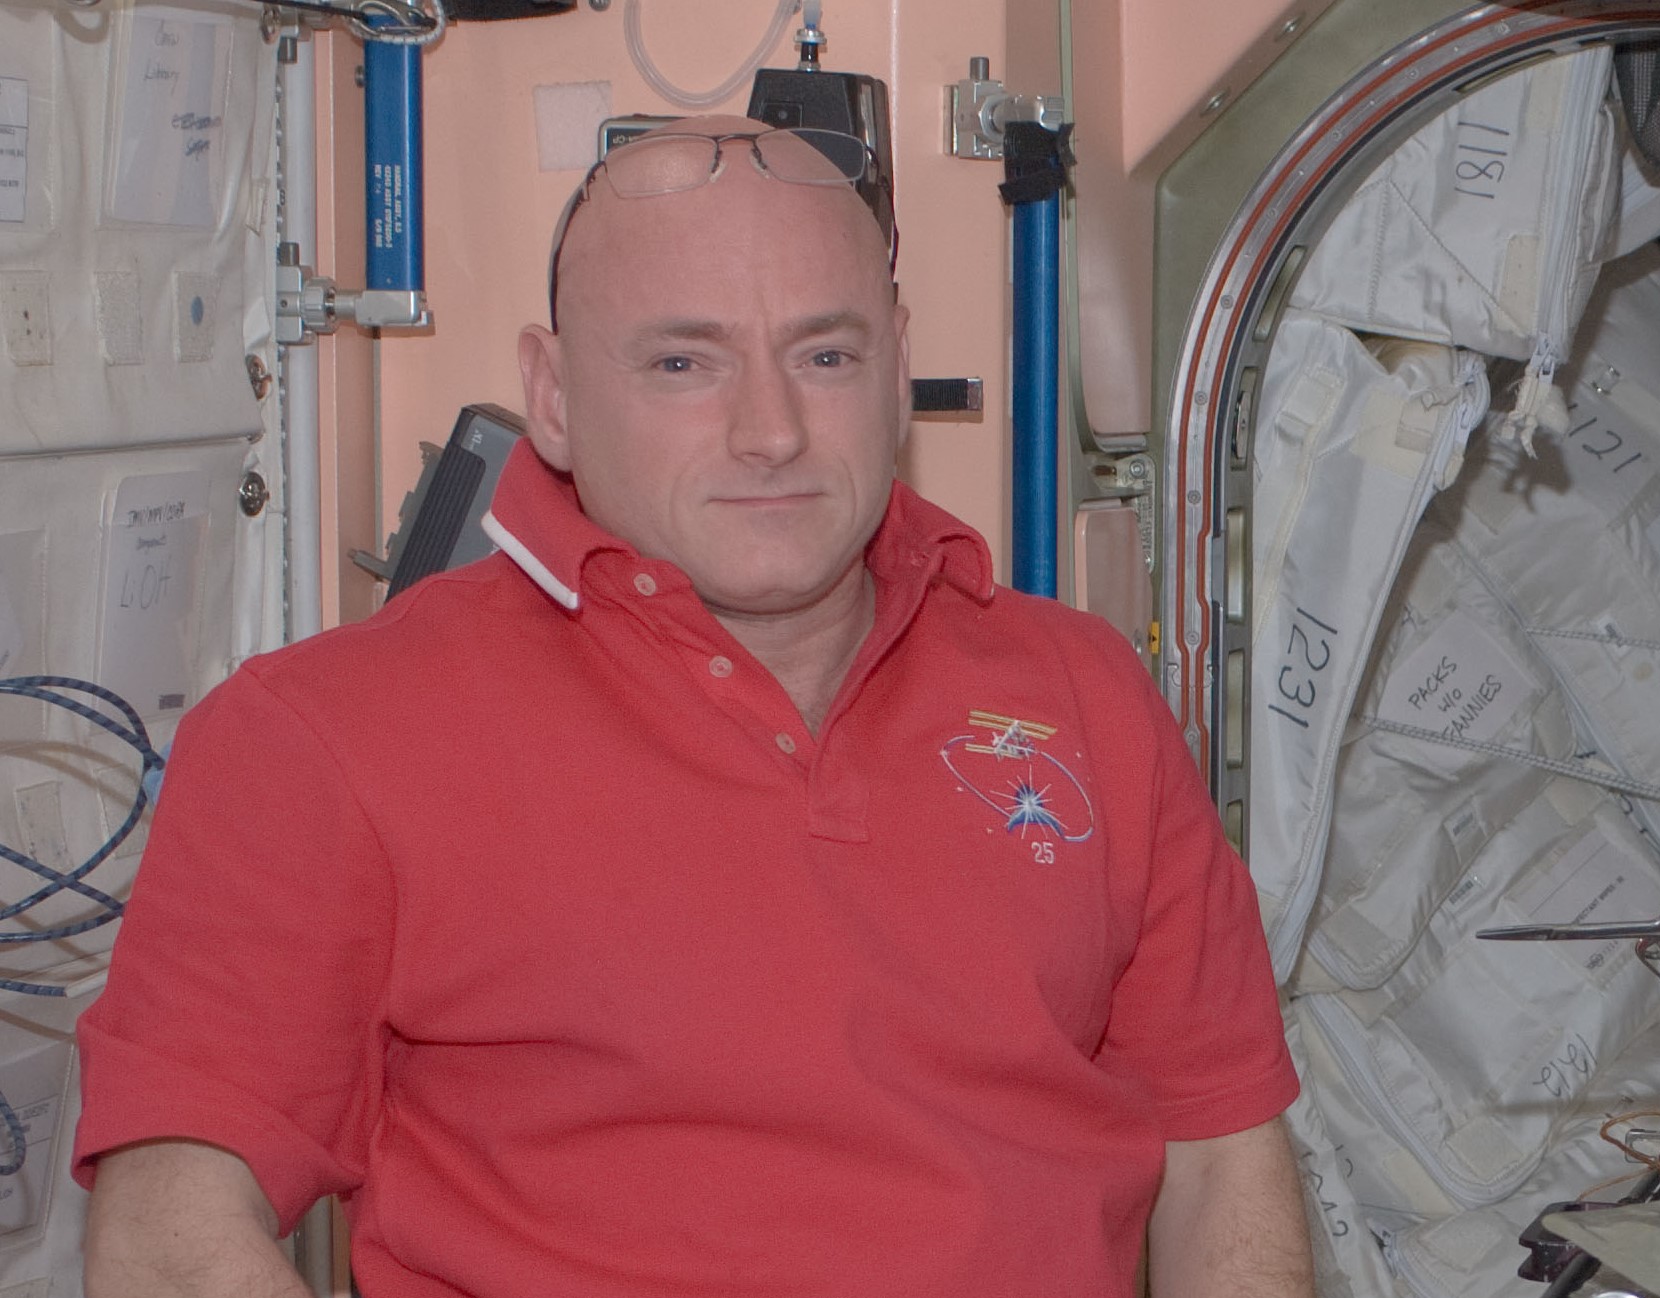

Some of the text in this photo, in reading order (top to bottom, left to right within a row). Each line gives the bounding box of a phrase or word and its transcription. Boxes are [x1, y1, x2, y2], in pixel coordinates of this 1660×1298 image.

[1567, 402, 1643, 475] 121
[1267, 606, 1338, 727] 1231
[1407, 655, 1458, 711] PACKS
[1031, 841, 1056, 865] 25
